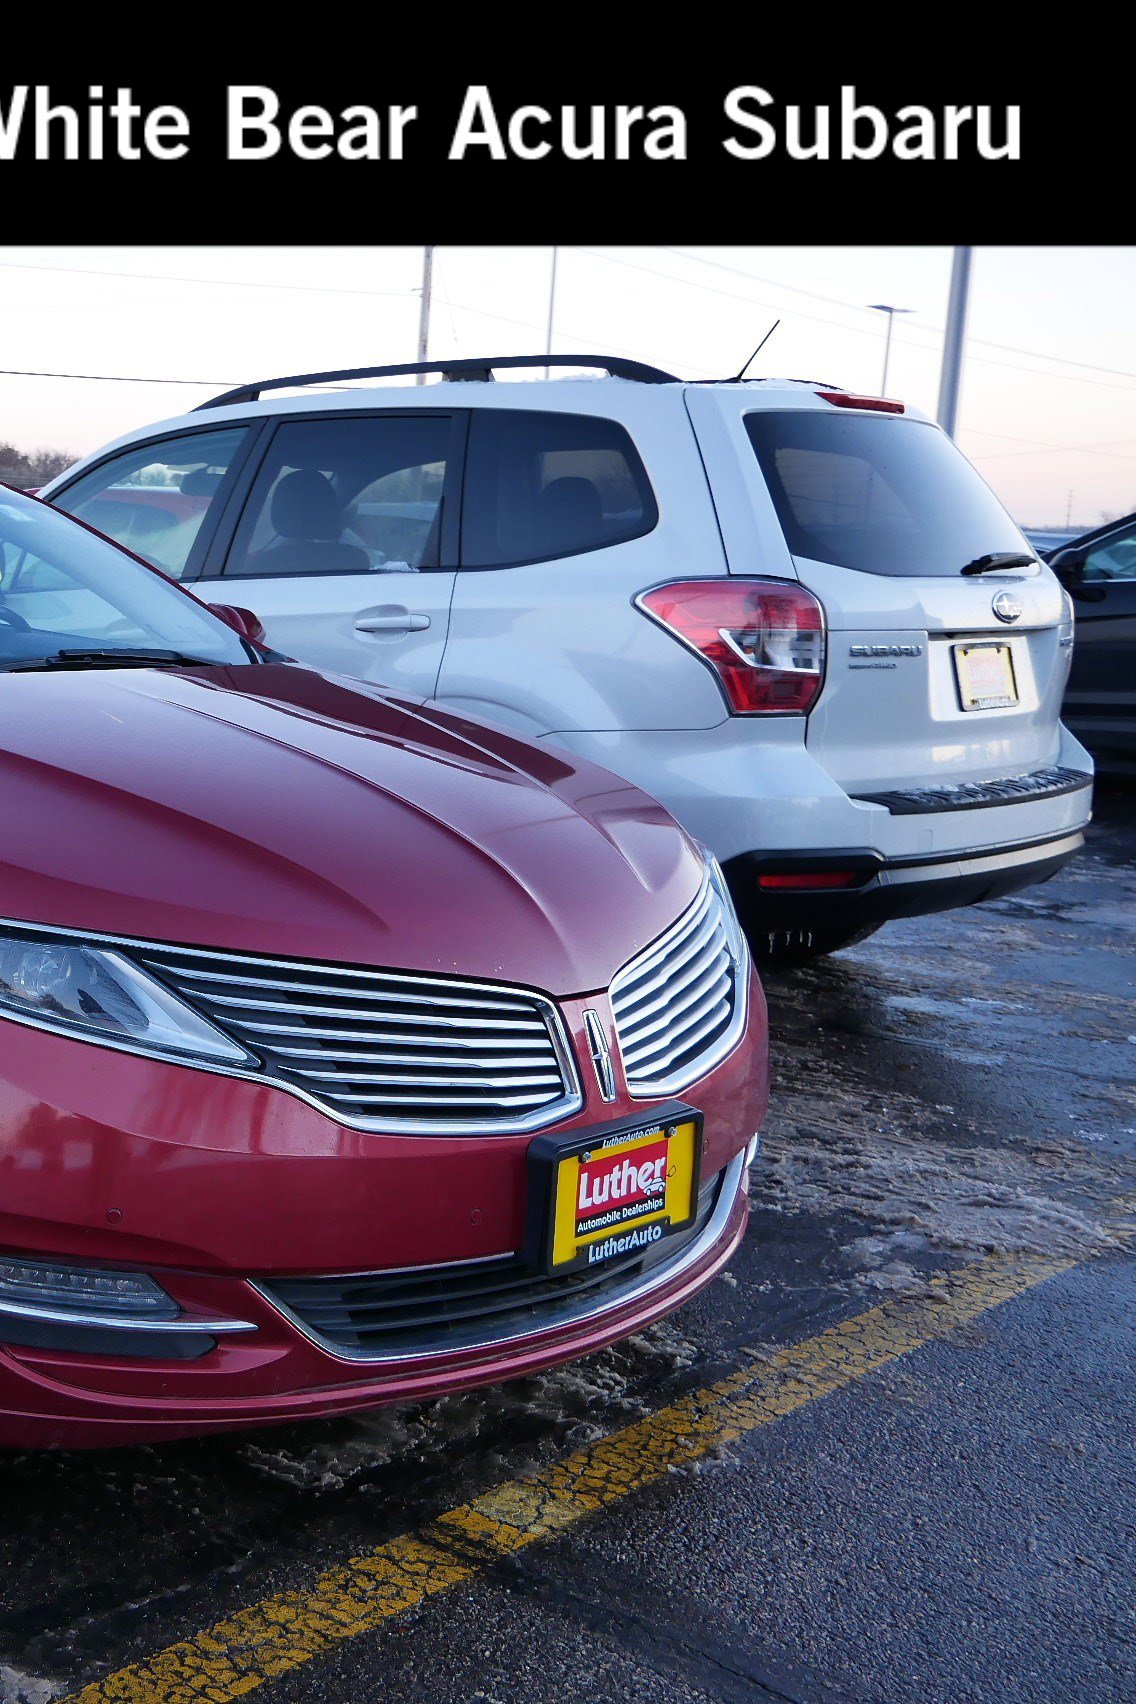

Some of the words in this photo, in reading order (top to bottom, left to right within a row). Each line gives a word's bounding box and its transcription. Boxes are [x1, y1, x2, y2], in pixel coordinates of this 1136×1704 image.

[849, 645, 923, 657] SUBARU
[602, 1125, 660, 1148] LutherAuto.com
[578, 1156, 666, 1210] Luther
[577, 1209, 621, 1233] Automobile
[622, 1198, 663, 1218] Dealerships
[588, 1225, 662, 1263] LutherAuto
